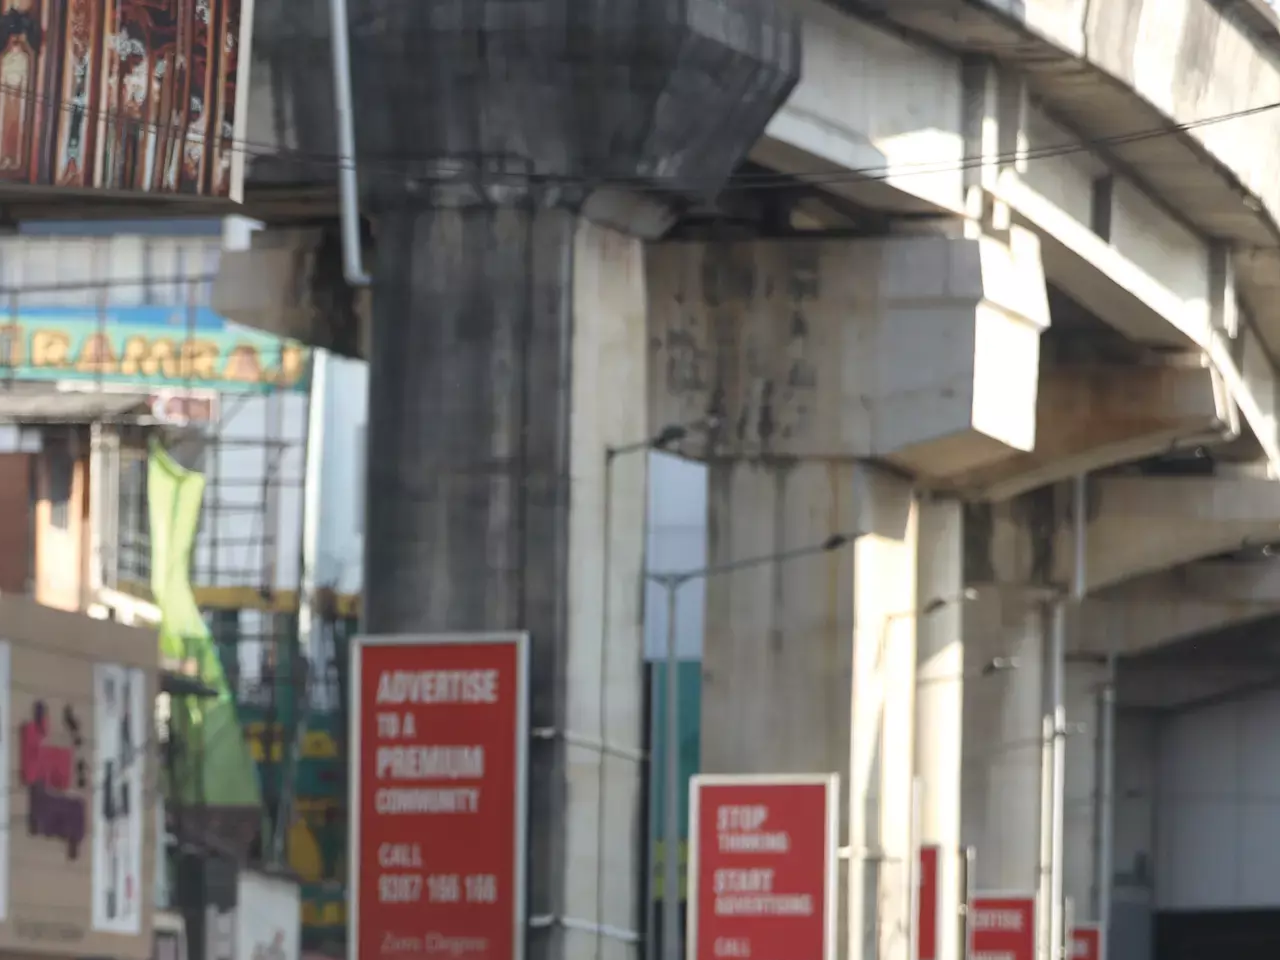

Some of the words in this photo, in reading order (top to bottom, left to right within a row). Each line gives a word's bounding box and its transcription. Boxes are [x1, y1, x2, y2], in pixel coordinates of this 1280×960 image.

[376, 669, 499, 704] ADVERTISE
[377, 711, 398, 739] TO
[376, 745, 484, 780] PREMIUM
[375, 787, 480, 814] COMMUNITY
[717, 805, 767, 831] STOP
[378, 843, 422, 868] CALL
[714, 867, 774, 893] START
